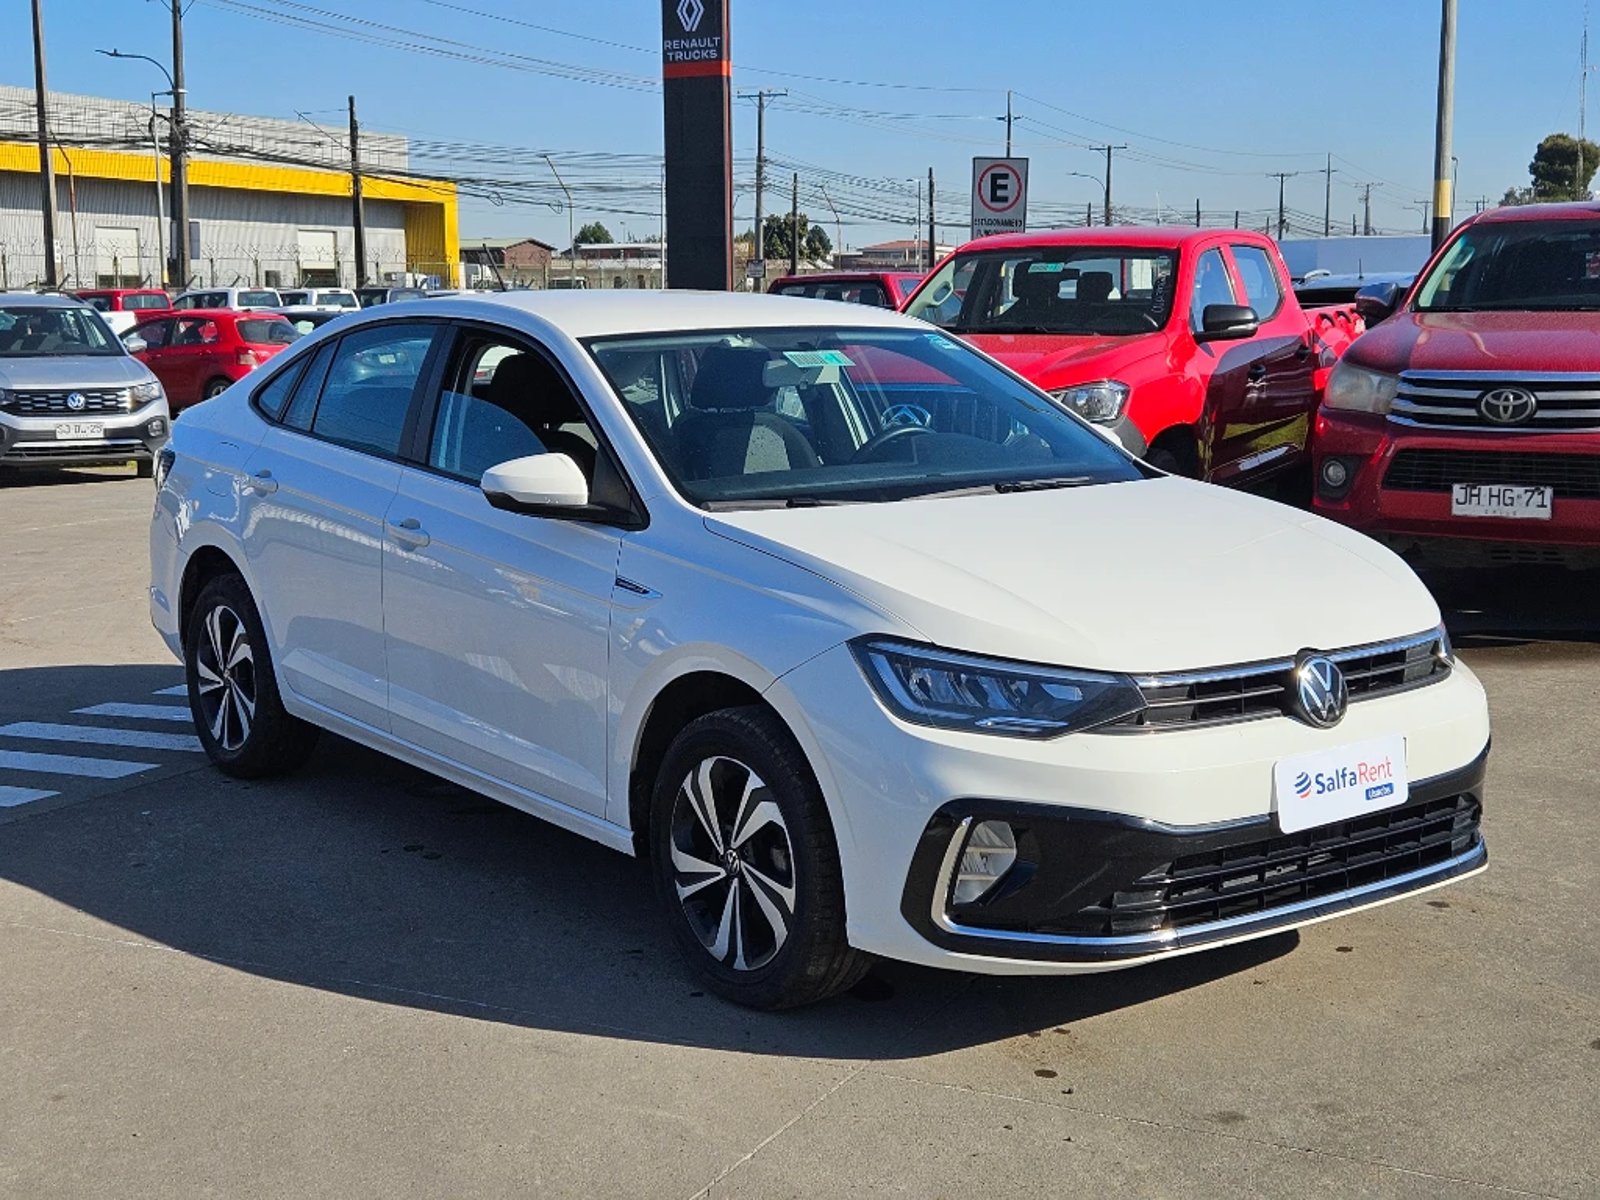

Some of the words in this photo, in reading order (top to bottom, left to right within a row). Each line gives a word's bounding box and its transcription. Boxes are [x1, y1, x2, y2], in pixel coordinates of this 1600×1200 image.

[664, 37, 720, 50] RENAULT
[667, 49, 718, 61] TRUCKS
[991, 173, 1009, 203] E
[1455, 486, 1482, 506] JH
[1524, 489, 1548, 509] 71
[1315, 757, 1393, 795] SalfaRent
